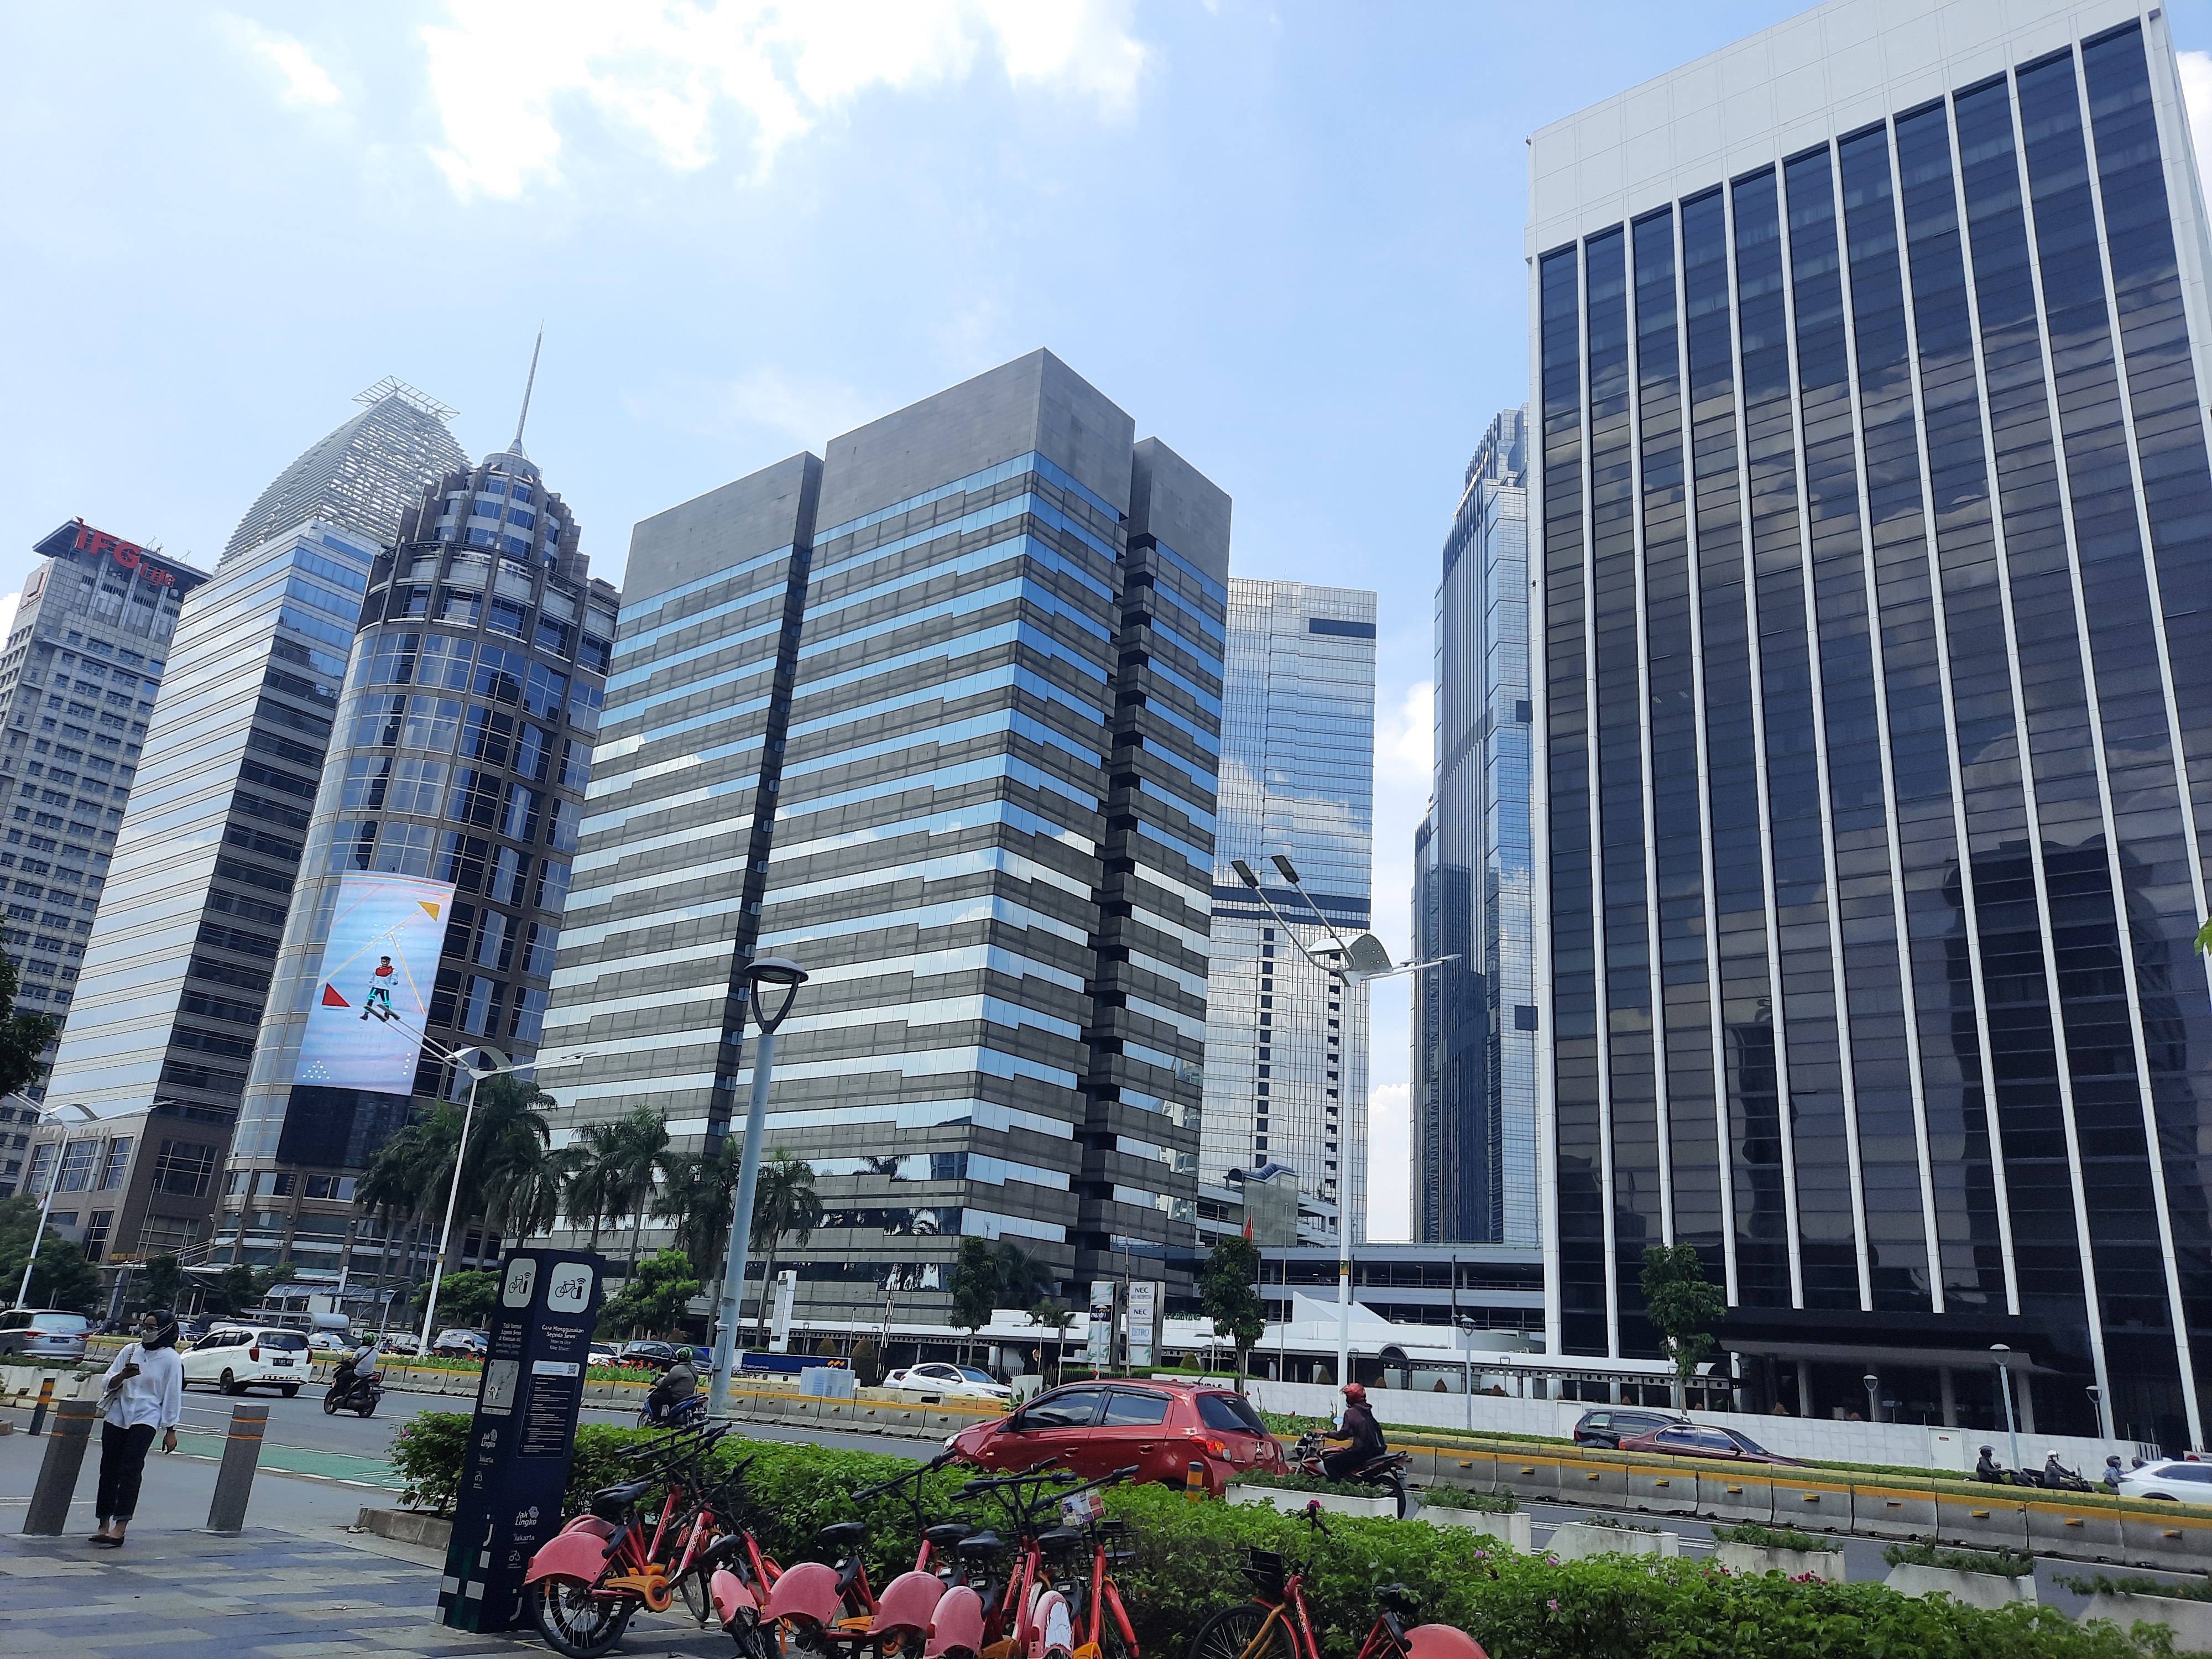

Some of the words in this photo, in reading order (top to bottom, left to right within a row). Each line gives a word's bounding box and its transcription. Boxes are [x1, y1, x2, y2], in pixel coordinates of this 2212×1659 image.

[75, 517, 141, 569] IFG
[139, 562, 176, 588] Life
[1130, 1327, 1150, 1337] JETRO
[515, 1516, 537, 1527] Lingko
